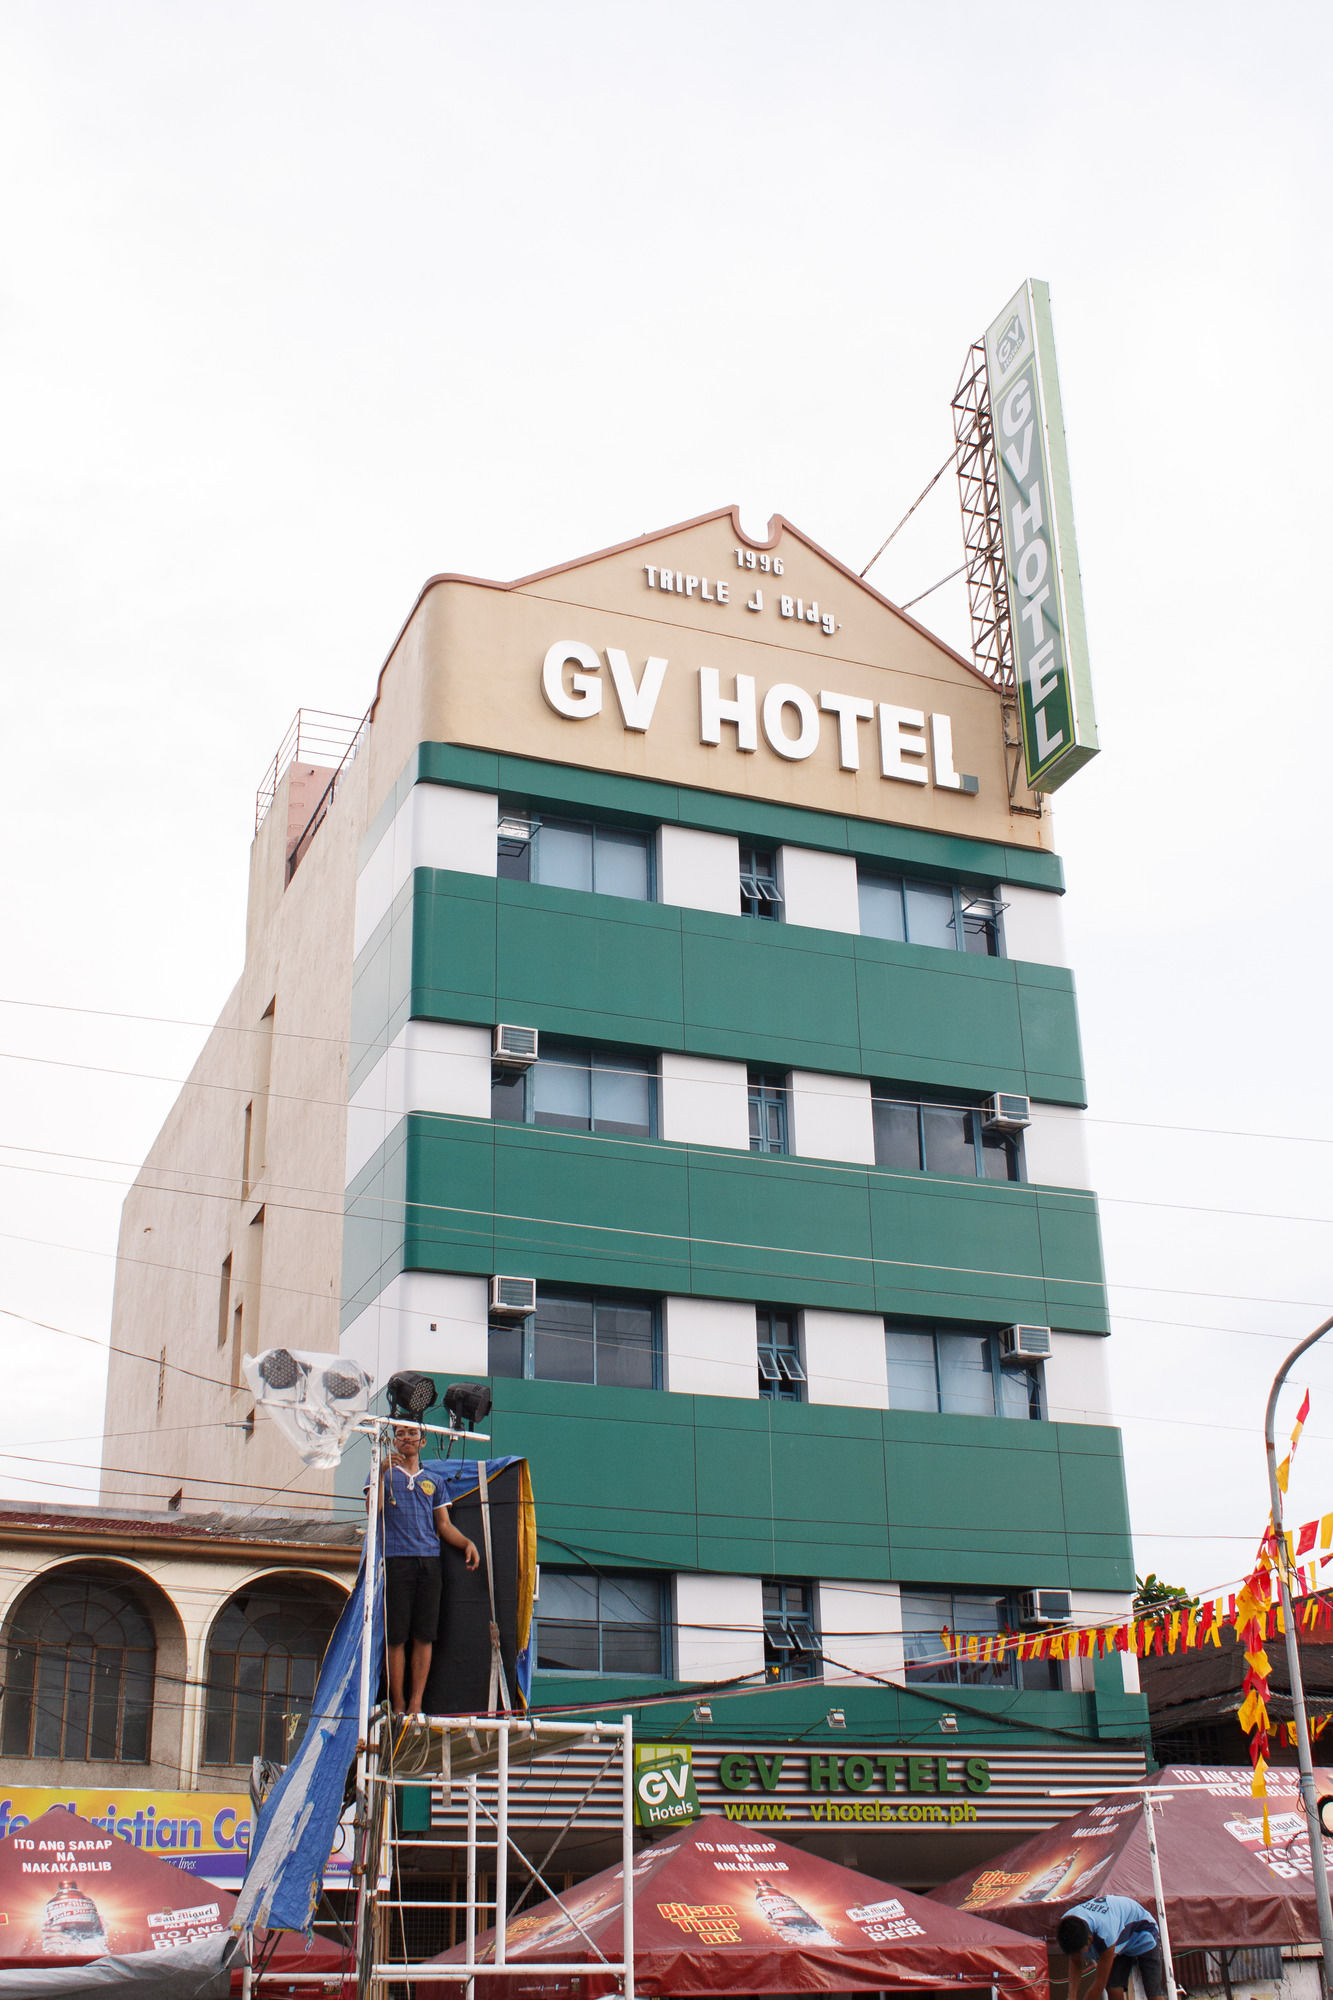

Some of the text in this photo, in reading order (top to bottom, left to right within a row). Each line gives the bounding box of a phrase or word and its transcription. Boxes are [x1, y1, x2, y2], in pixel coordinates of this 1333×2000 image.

[734, 548, 785, 576] 1996
[643, 564, 843, 635] TRIPLE J Bldg.
[1012, 488, 1063, 764] HOTEL
[540, 640, 979, 796] GV HOTEL
[719, 1753, 992, 1793] GV HOTELS
[1172, 1770, 1200, 1782] ITO
[1200, 1770, 1233, 1783] ANG
[638, 1763, 690, 1806] GV
[649, 1800, 694, 1823] Hotels
[724, 1804, 791, 1821] www.
[1234, 1823, 1262, 1837] San
[14, 1839, 113, 1851] ITO ANG SARAP
[695, 1842, 777, 1853] ITO ANG SARAP
[56, 1852, 76, 1862] NA
[734, 1853, 755, 1863] NA
[22, 1861, 113, 1873] NAKAKABILIB
[713, 1862, 790, 1872] NAKAKABILIB
[657, 1903, 736, 1919] Pilsen
[151, 1923, 224, 1941] ITO ANG
[671, 1917, 740, 1933] Time
[860, 1917, 917, 1934] ITO ANG
[699, 1928, 742, 1945] na!
[867, 1925, 928, 1943] BEER
